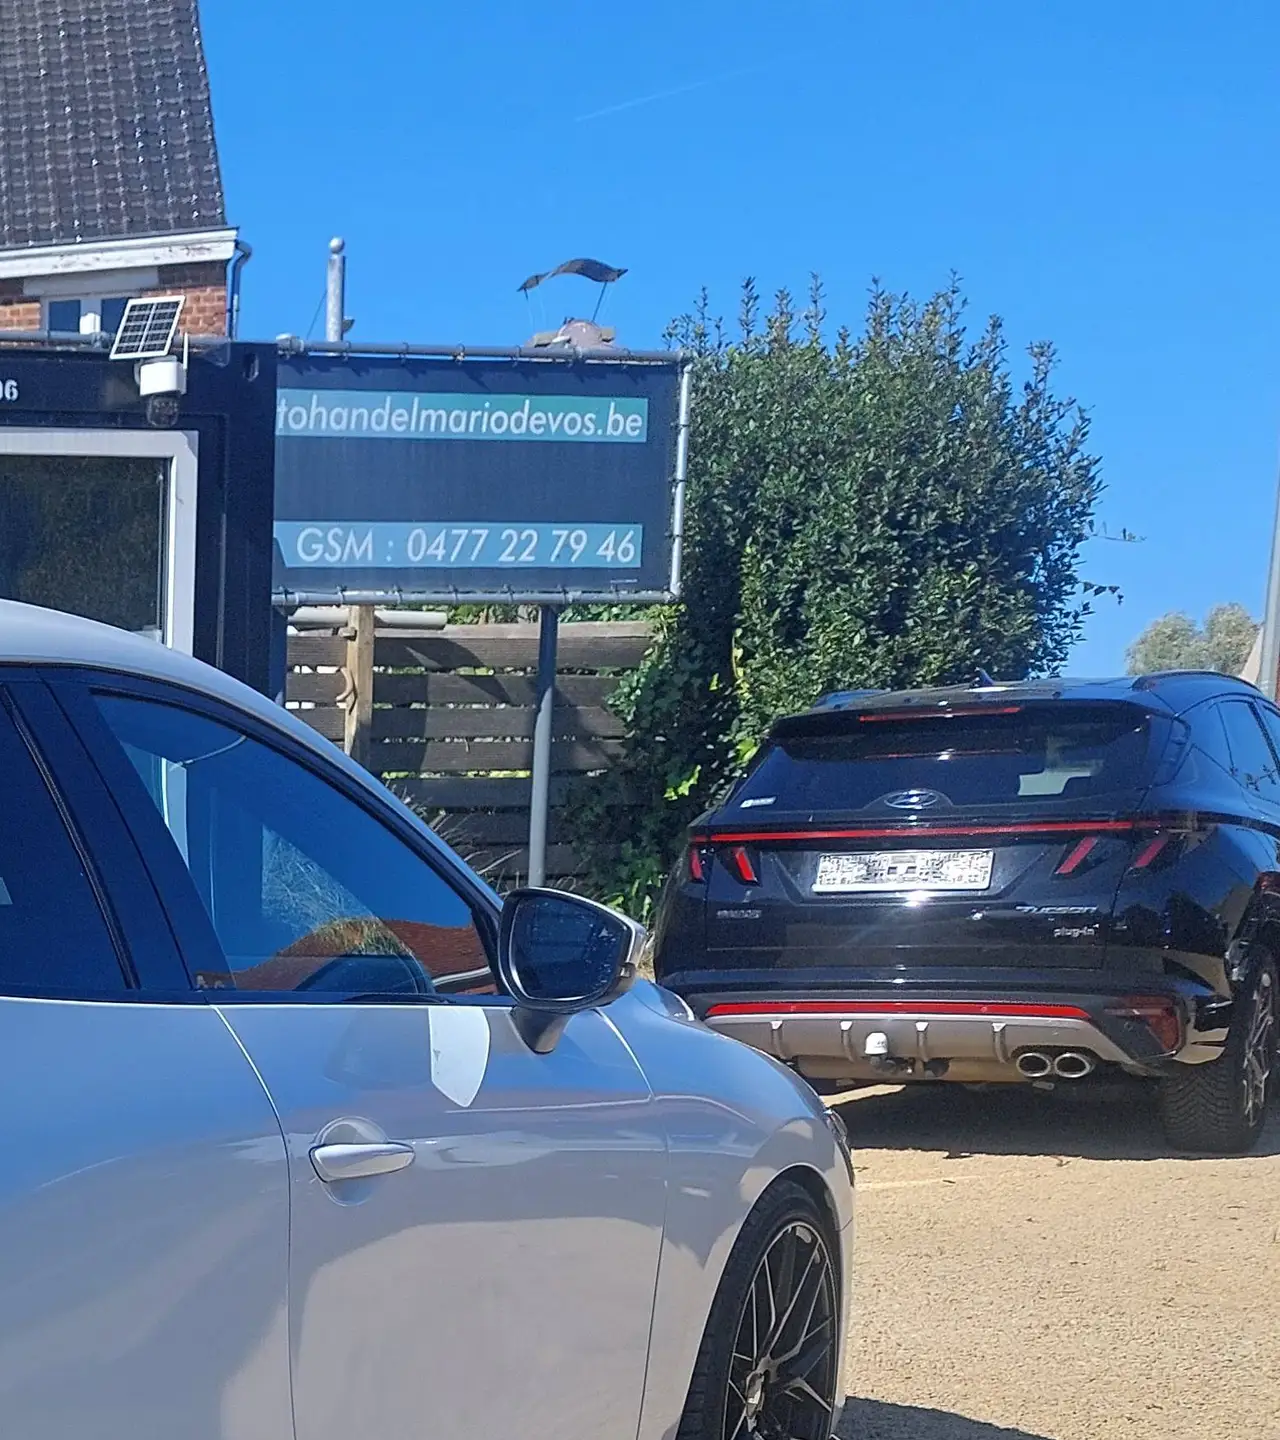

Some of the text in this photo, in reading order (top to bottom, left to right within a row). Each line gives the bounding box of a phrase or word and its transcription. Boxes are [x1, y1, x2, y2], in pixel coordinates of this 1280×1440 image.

[296, 526, 374, 562] GSM
[406, 527, 490, 563] 0477
[498, 528, 538, 563] 22
[550, 529, 588, 563] 79
[596, 529, 636, 564] 46
